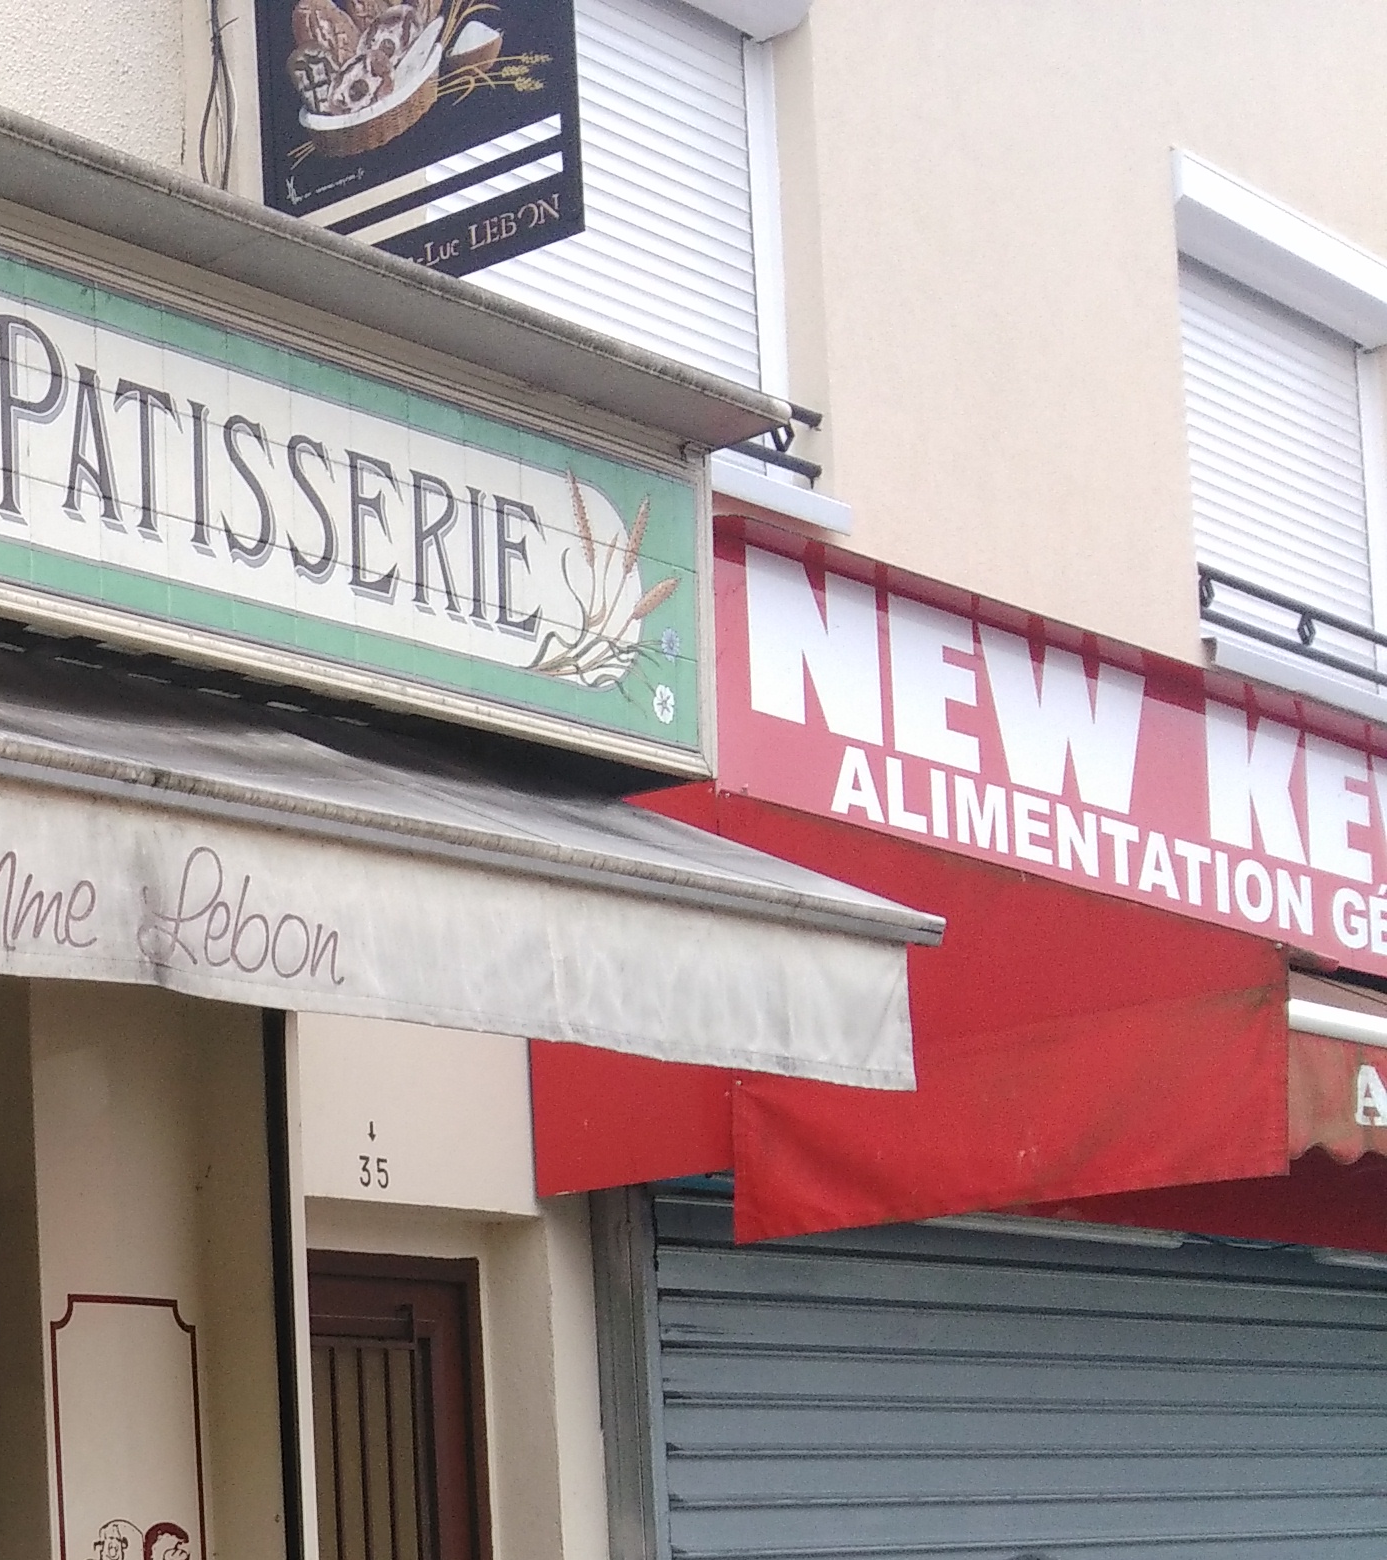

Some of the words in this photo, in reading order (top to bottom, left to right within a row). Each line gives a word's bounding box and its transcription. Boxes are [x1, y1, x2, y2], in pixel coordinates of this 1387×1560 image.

[468, 192, 561, 250] LEBON
[745, 543, 1146, 815] NEW
[1205, 697, 1387, 885] KE
[830, 745, 1314, 936] ALIMENTATION
[139, 845, 345, 986] Lebon
[358, 1154, 390, 1189] 35
